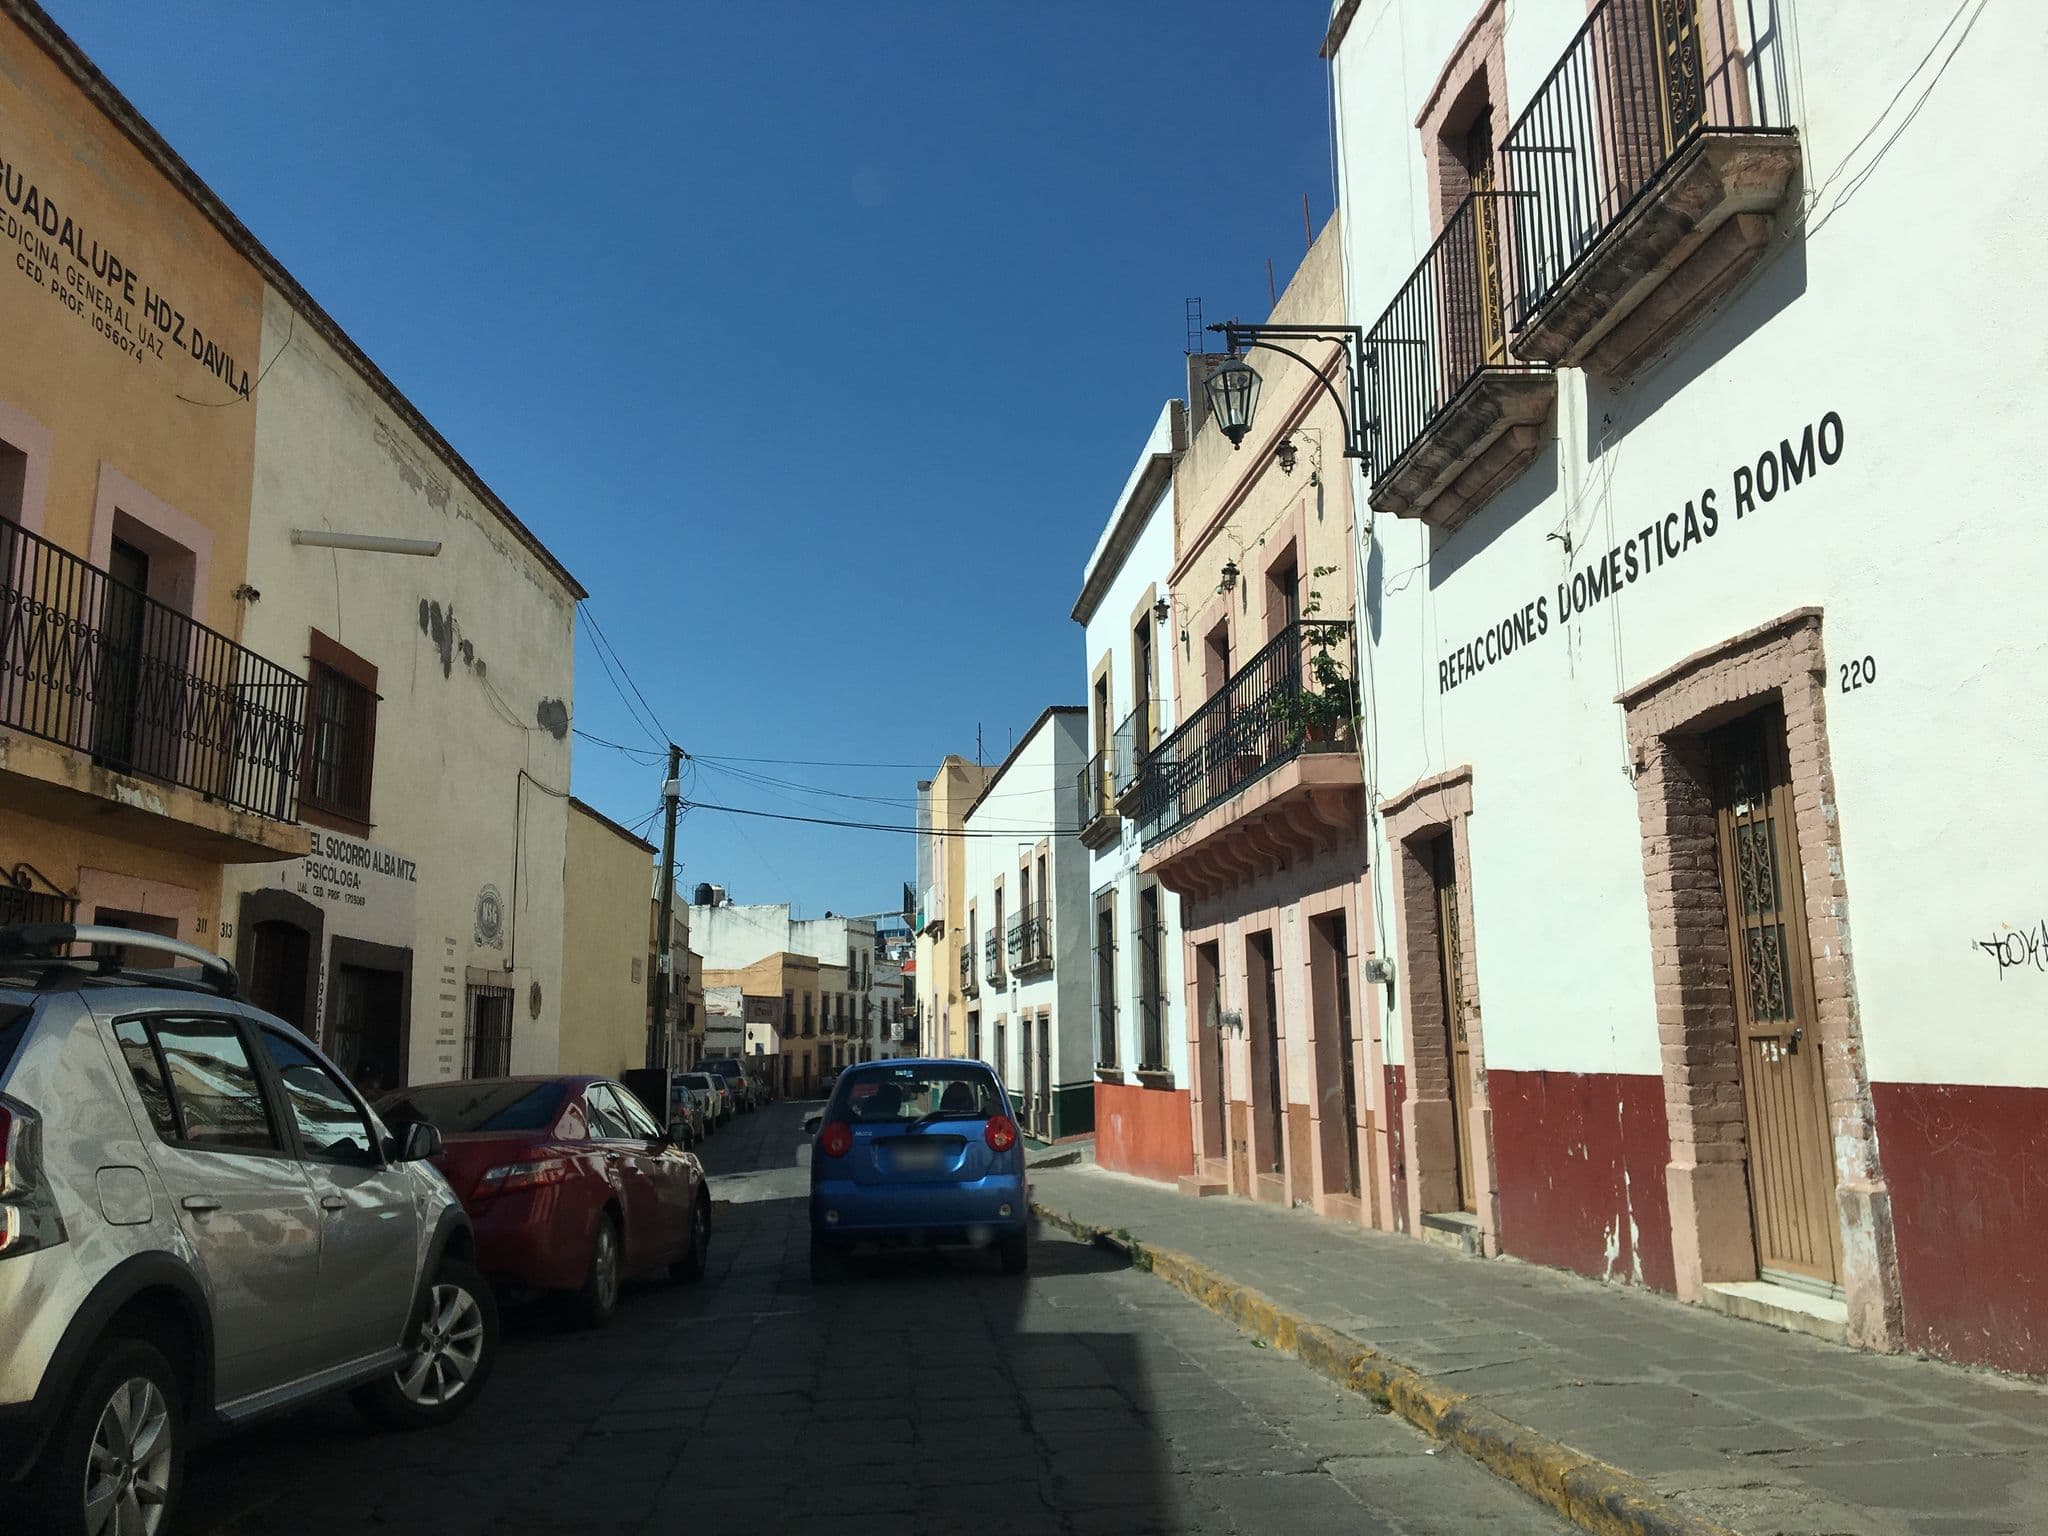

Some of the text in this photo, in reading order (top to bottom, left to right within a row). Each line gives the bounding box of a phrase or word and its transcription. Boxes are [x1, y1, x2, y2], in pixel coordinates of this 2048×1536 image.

[0, 157, 250, 401] UADALUPE HDZ. DAVILA
[16, 253, 143, 364] CED. PROF. 1056074
[66, 265, 132, 334] GENERAL
[138, 323, 164, 360] UAZ
[1439, 411, 1844, 695] REFACCIONES DOMESTICAS ROMO
[1840, 655, 1876, 693] 220
[326, 837, 371, 870] SOCORRO
[196, 917, 208, 933] 311
[220, 922, 232, 938] 313
